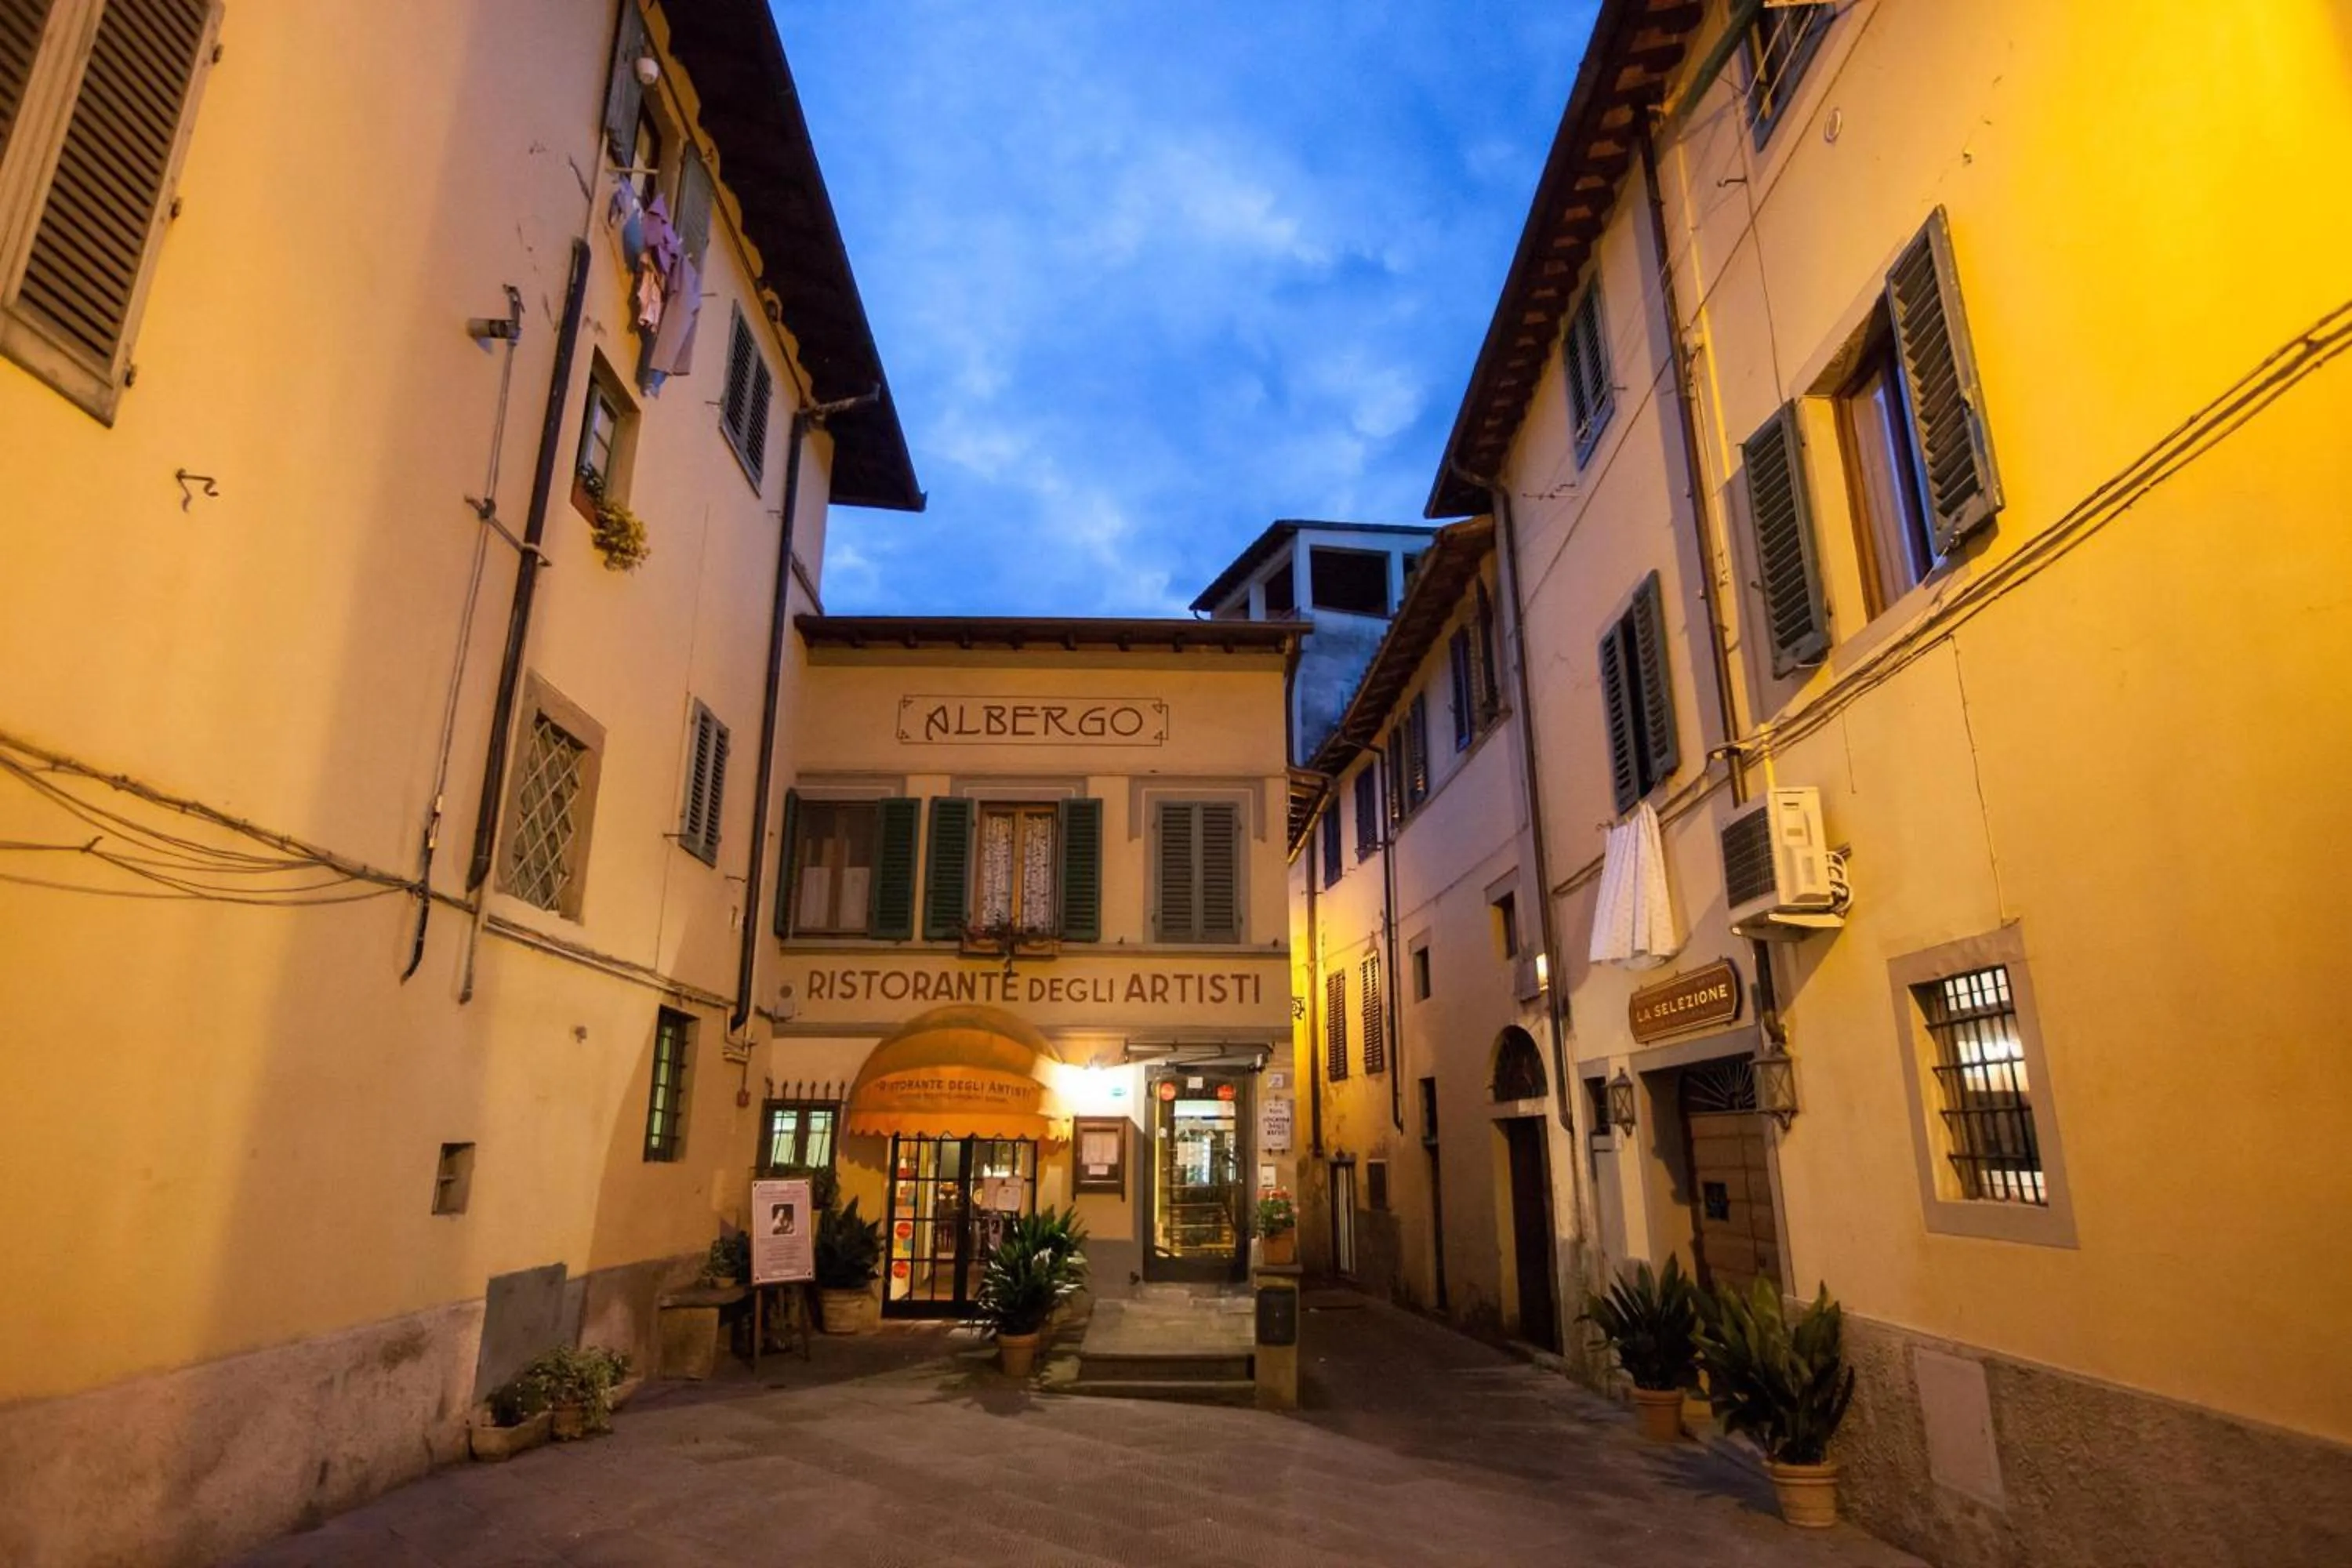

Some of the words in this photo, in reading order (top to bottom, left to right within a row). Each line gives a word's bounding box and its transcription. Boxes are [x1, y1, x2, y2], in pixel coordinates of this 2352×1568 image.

[925, 705, 1143, 741] ALBERGO
[807, 970, 1019, 1002] RISTORANTE
[1028, 978, 1114, 1003] DEGLI
[1123, 973, 1260, 1004] ARTISTI
[1636, 1008, 1651, 1023] LA
[1653, 983, 1728, 1018] SELEZIONE
